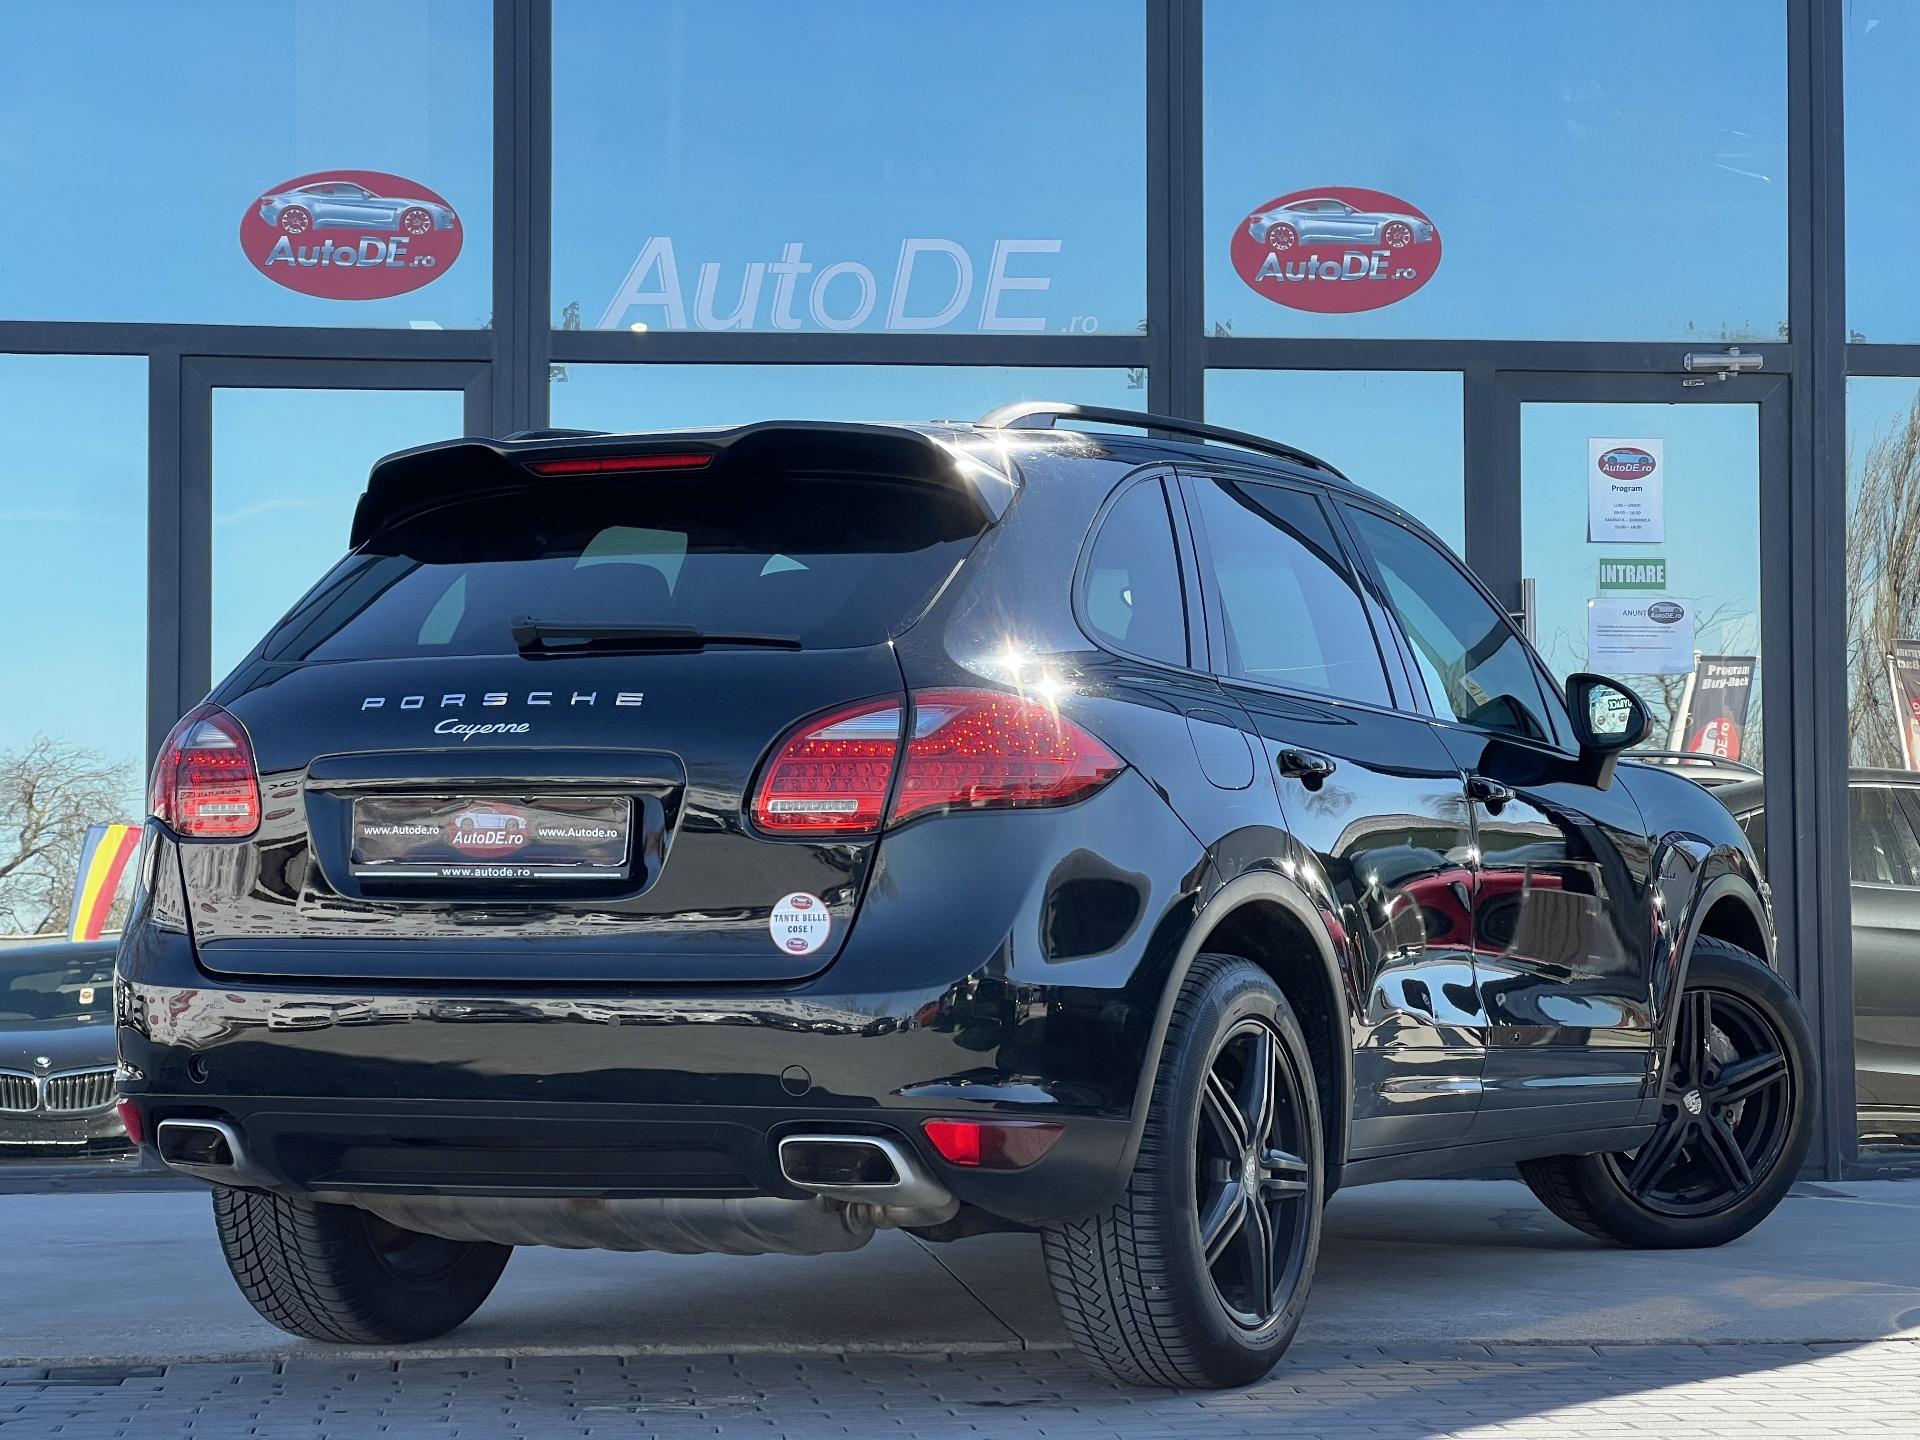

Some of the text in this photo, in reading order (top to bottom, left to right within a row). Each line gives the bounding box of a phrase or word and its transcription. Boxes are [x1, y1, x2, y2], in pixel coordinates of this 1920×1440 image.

[264, 235, 436, 268] AutoDE.ro
[1254, 250, 1418, 282] AutoDE.ro
[1602, 463, 1652, 472] AutoDE.ro
[1611, 485, 1643, 493] Program
[1601, 564, 1665, 583] INTRARE
[1707, 664, 1750, 676] Program
[1701, 676, 1749, 690] Buy-Back
[360, 691, 644, 711] PORSCHE
[434, 718, 530, 741] Cayenne
[1715, 722, 1730, 757] DE.ro
[364, 825, 440, 836] www.Autode.ro
[538, 827, 618, 838] www.Autode.ro
[452, 831, 524, 846] AutoDE.ro
[442, 867, 531, 877] www.autode.ro
[774, 913, 828, 922] TANTE BELLE
[787, 925, 808, 933] COSE
